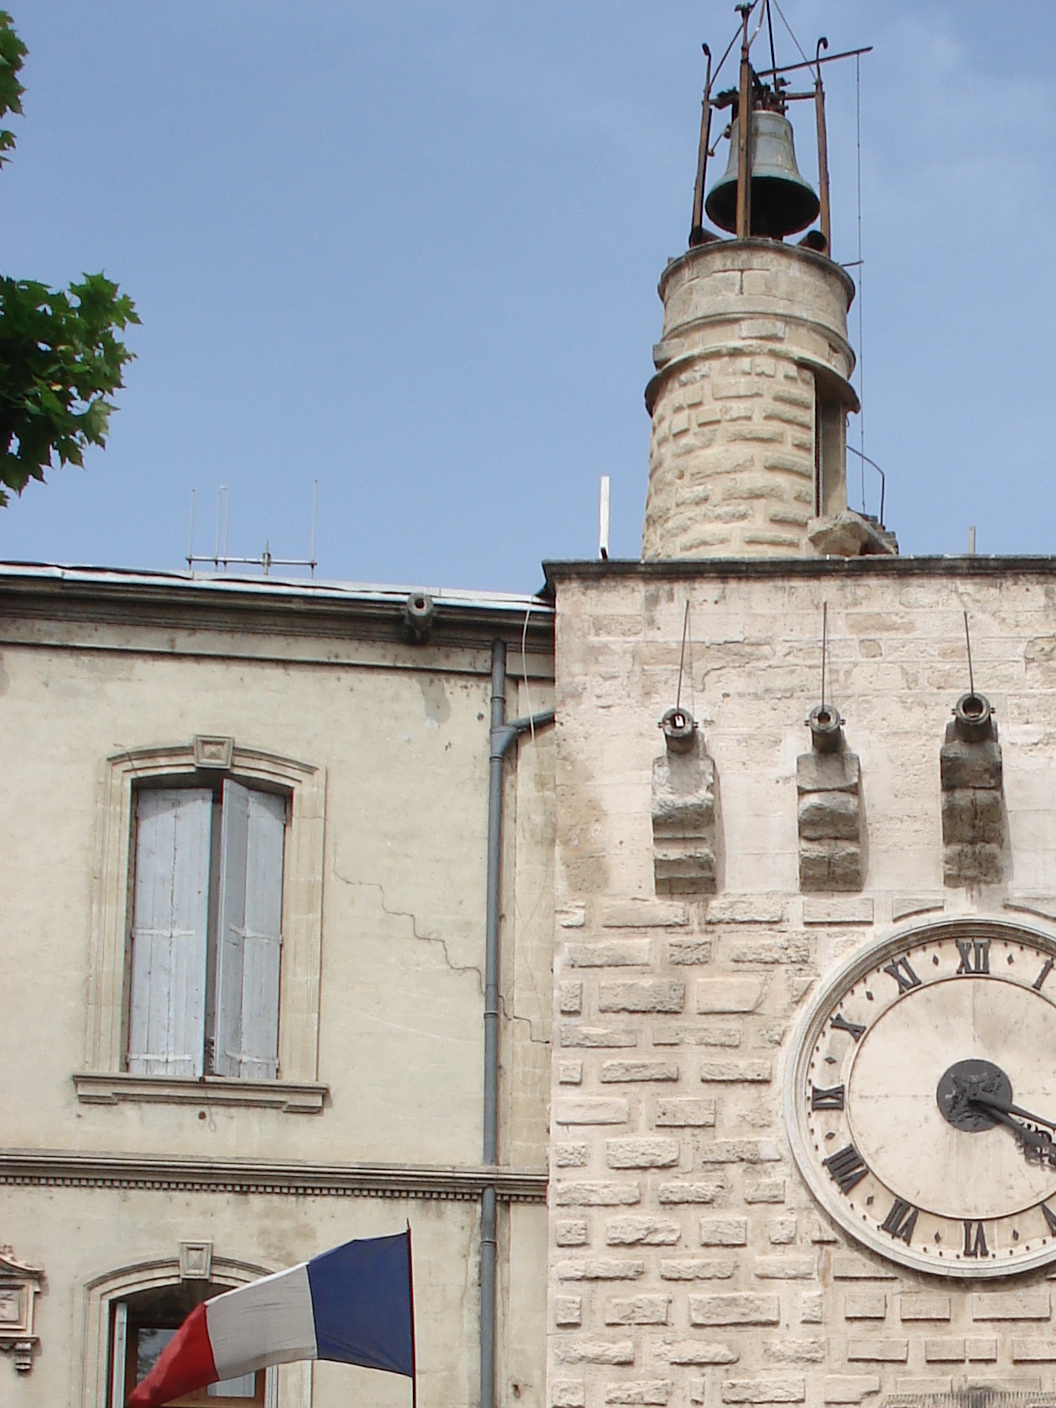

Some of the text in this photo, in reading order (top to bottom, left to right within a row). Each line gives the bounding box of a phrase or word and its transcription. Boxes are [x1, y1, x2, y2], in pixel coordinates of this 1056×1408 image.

[956, 939, 991, 974] XII
[885, 957, 922, 993] XI
[830, 1013, 866, 1041] X
